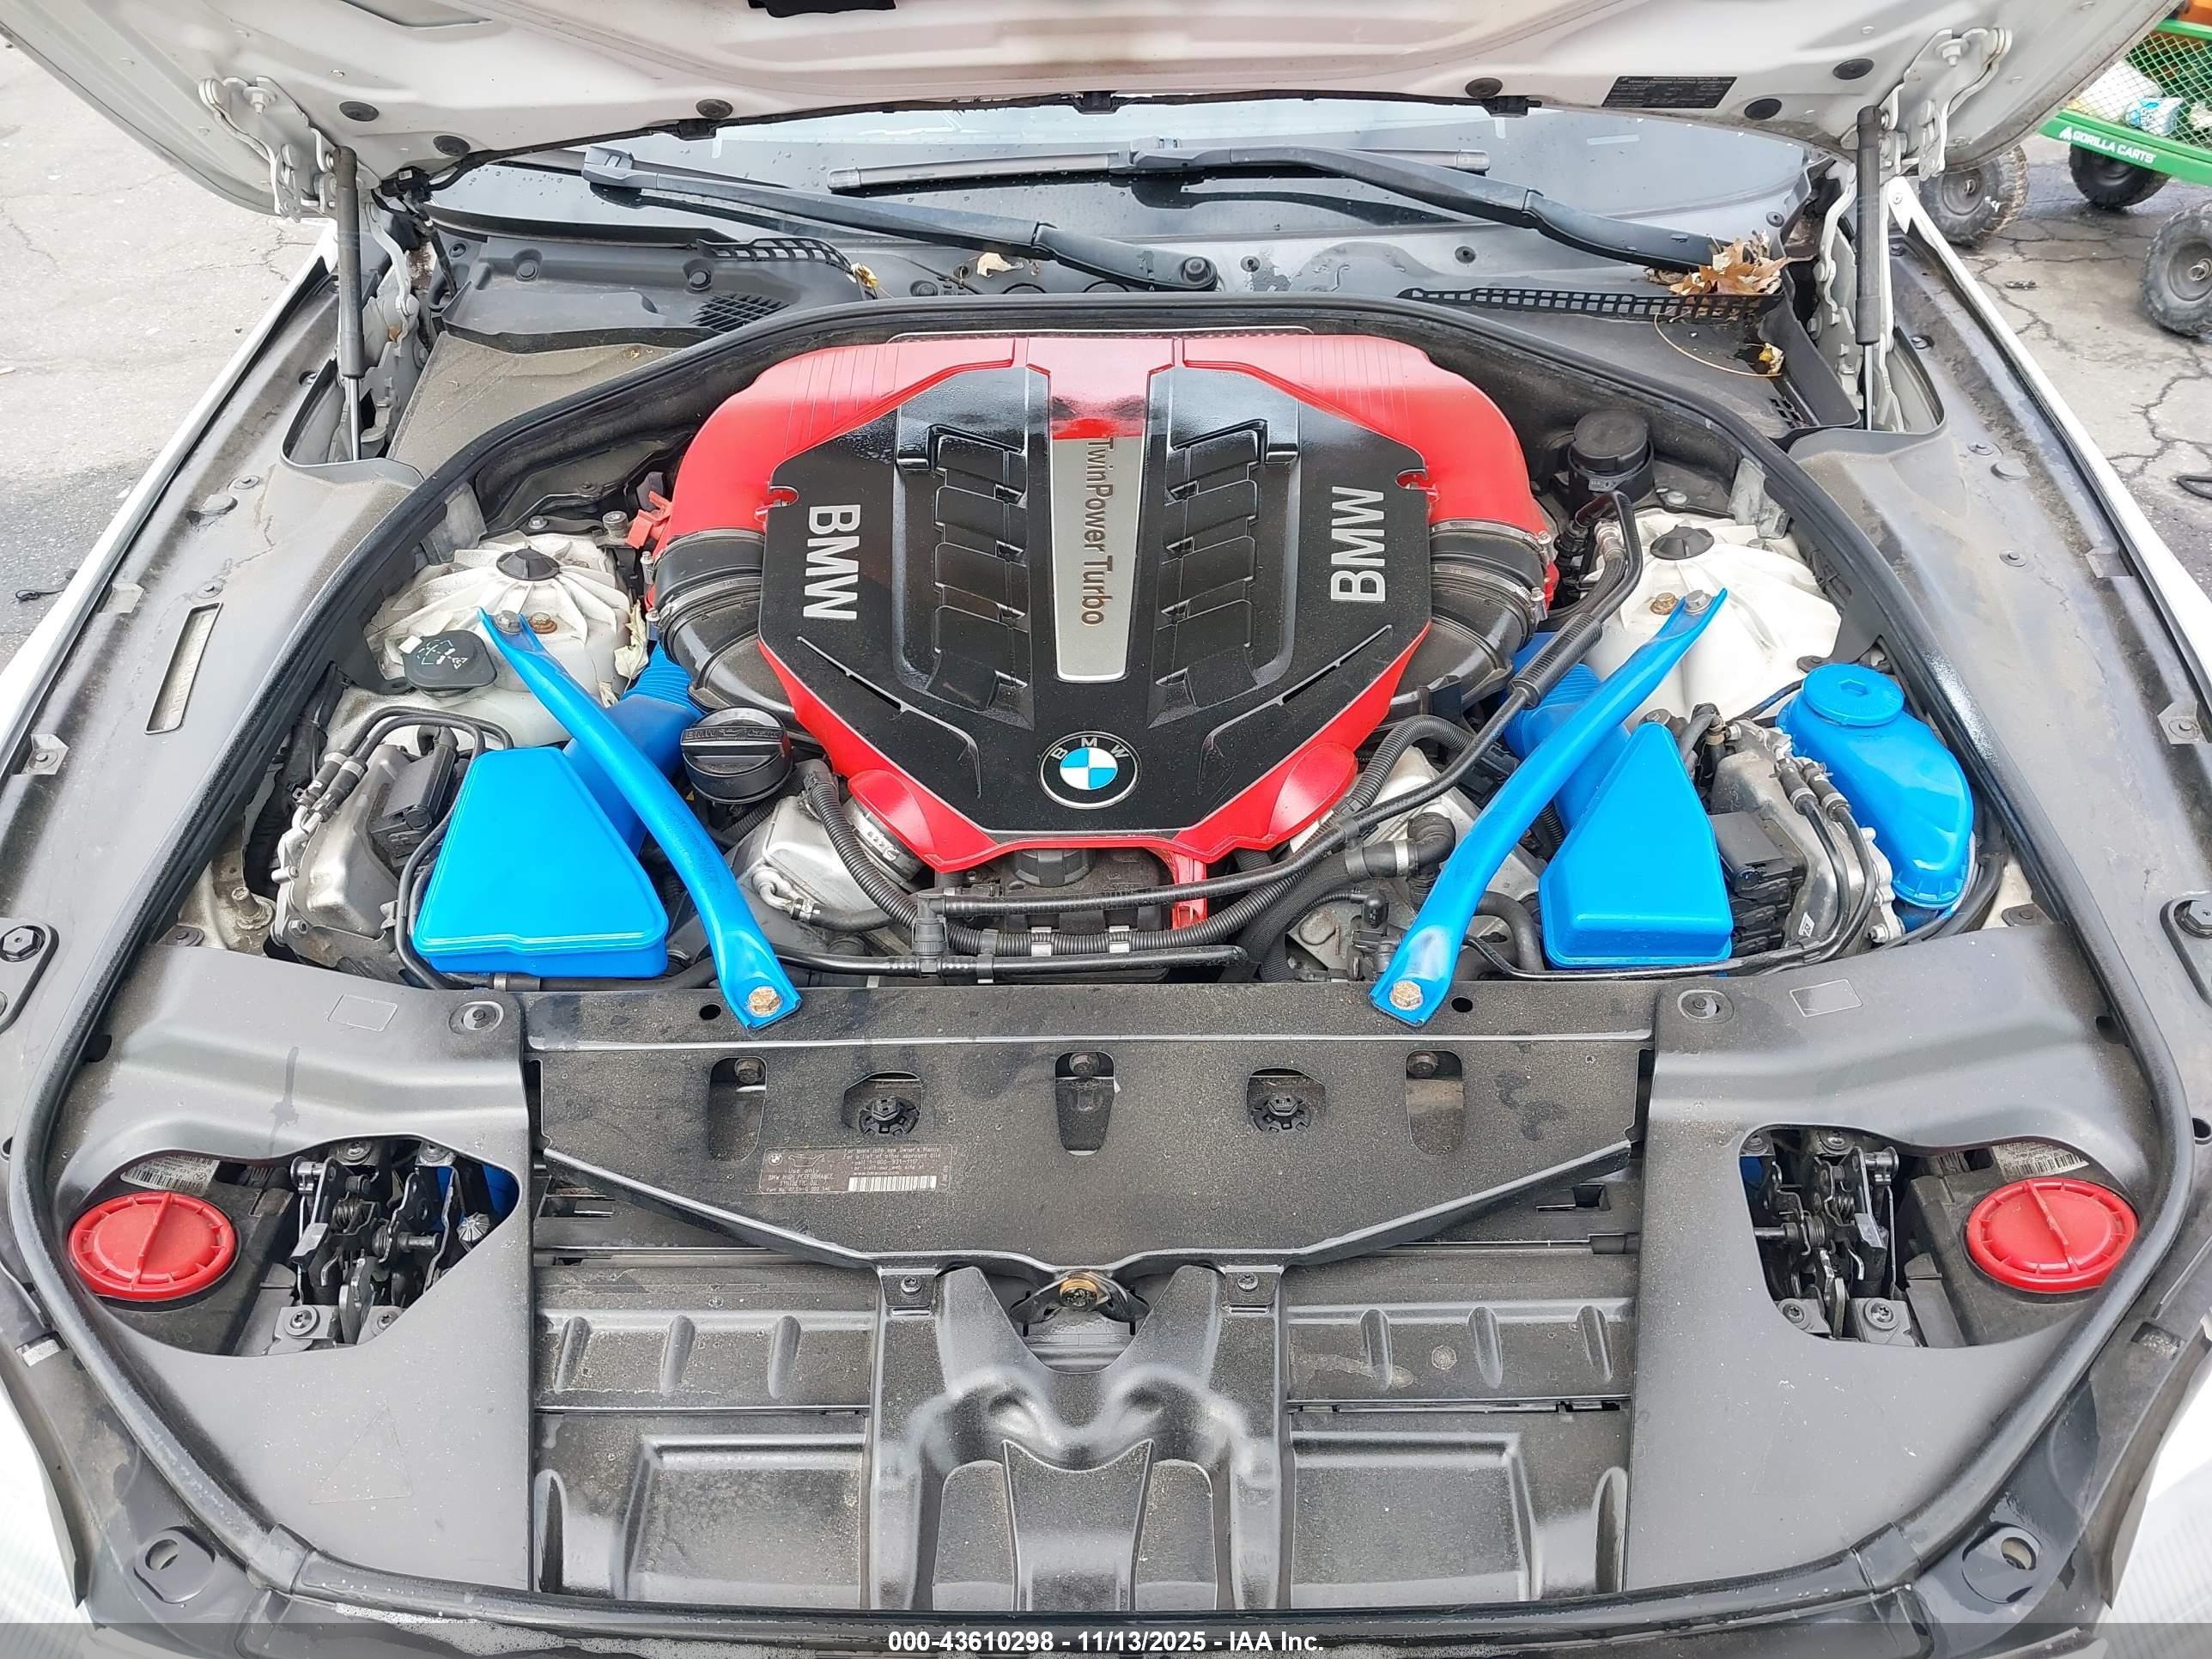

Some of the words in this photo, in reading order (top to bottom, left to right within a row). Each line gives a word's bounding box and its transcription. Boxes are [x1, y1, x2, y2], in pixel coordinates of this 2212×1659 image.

[2073, 130, 2116, 153] GORILLA
[2117, 143, 2155, 163] CARTS
[1085, 436, 1114, 553] TwinPower
[803, 504, 860, 619] BMW
[1331, 486, 1386, 601] BMW
[1081, 556, 1114, 625] Turbo
[686, 729, 716, 738] BMW
[1050, 737, 1129, 760] BMW
